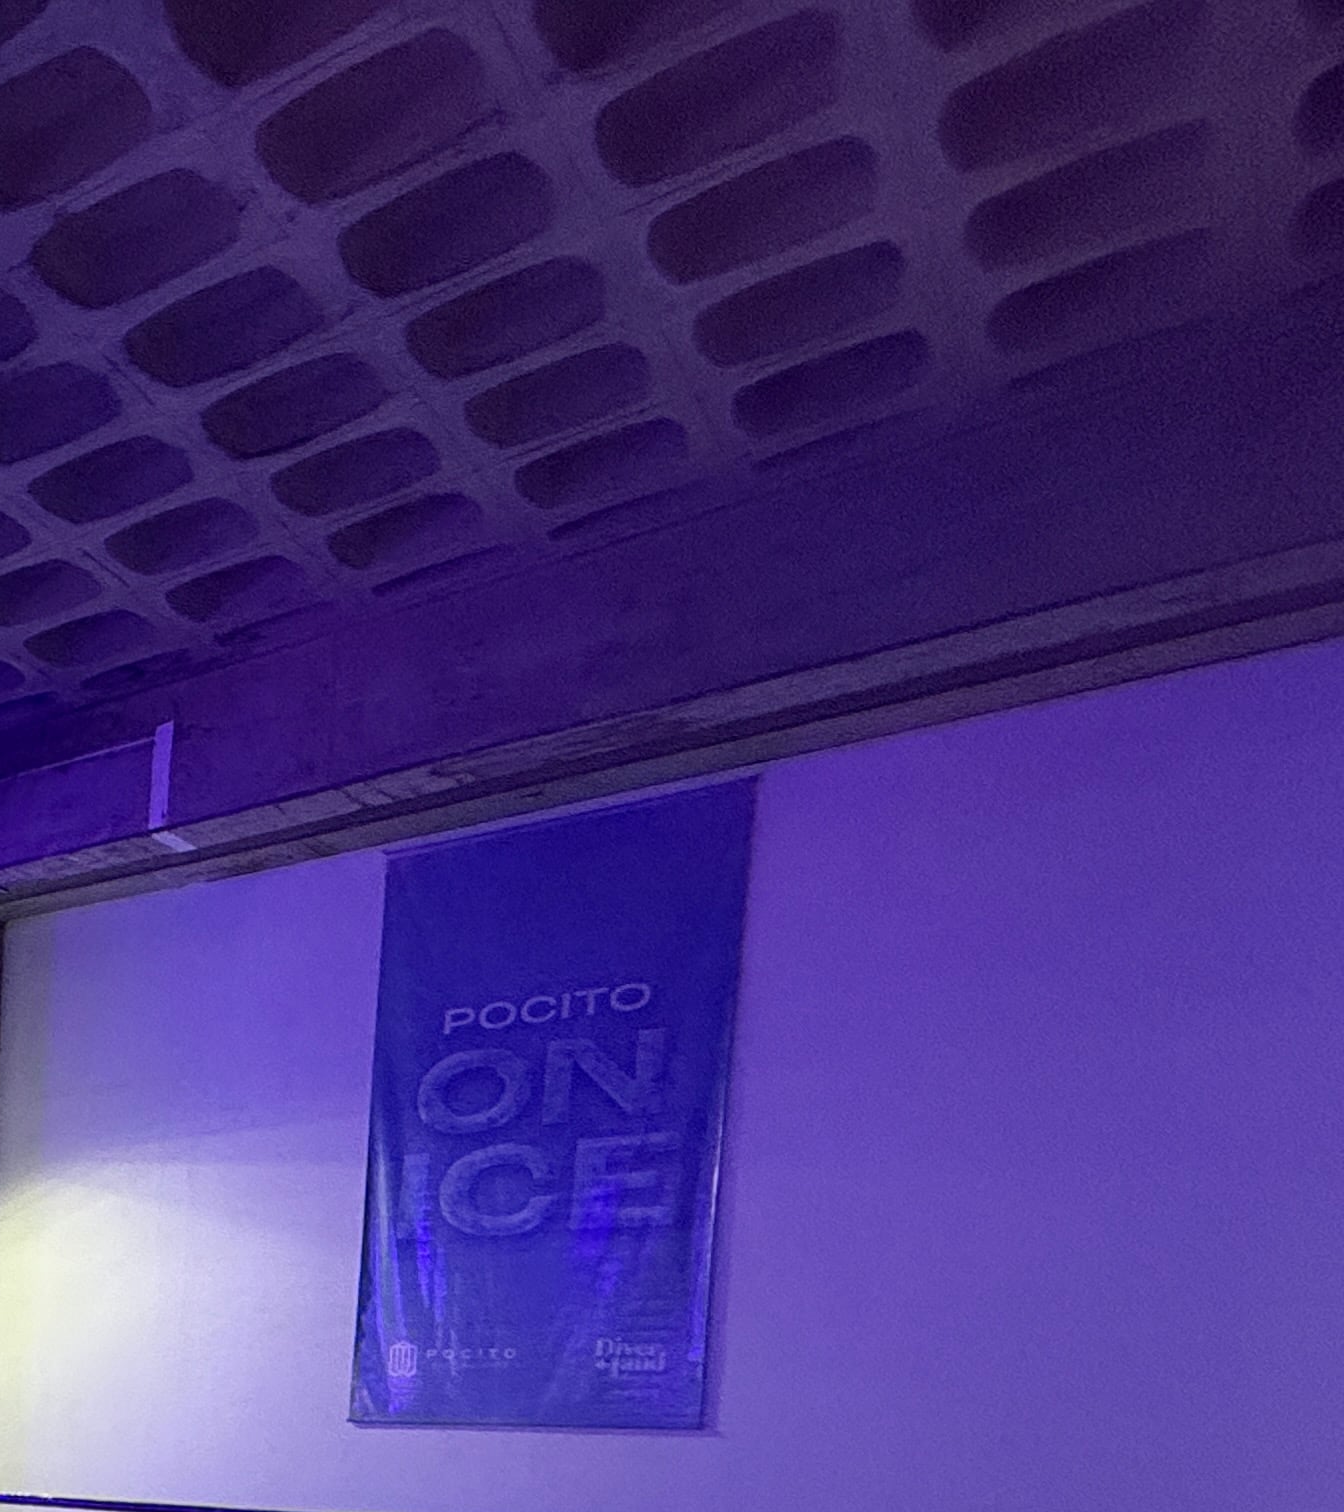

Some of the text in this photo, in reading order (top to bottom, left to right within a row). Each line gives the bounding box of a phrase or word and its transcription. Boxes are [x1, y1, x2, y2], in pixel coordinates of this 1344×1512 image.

[443, 982, 652, 1034] POCITO
[417, 1028, 668, 1135] ON
[398, 1132, 679, 1239] ICE
